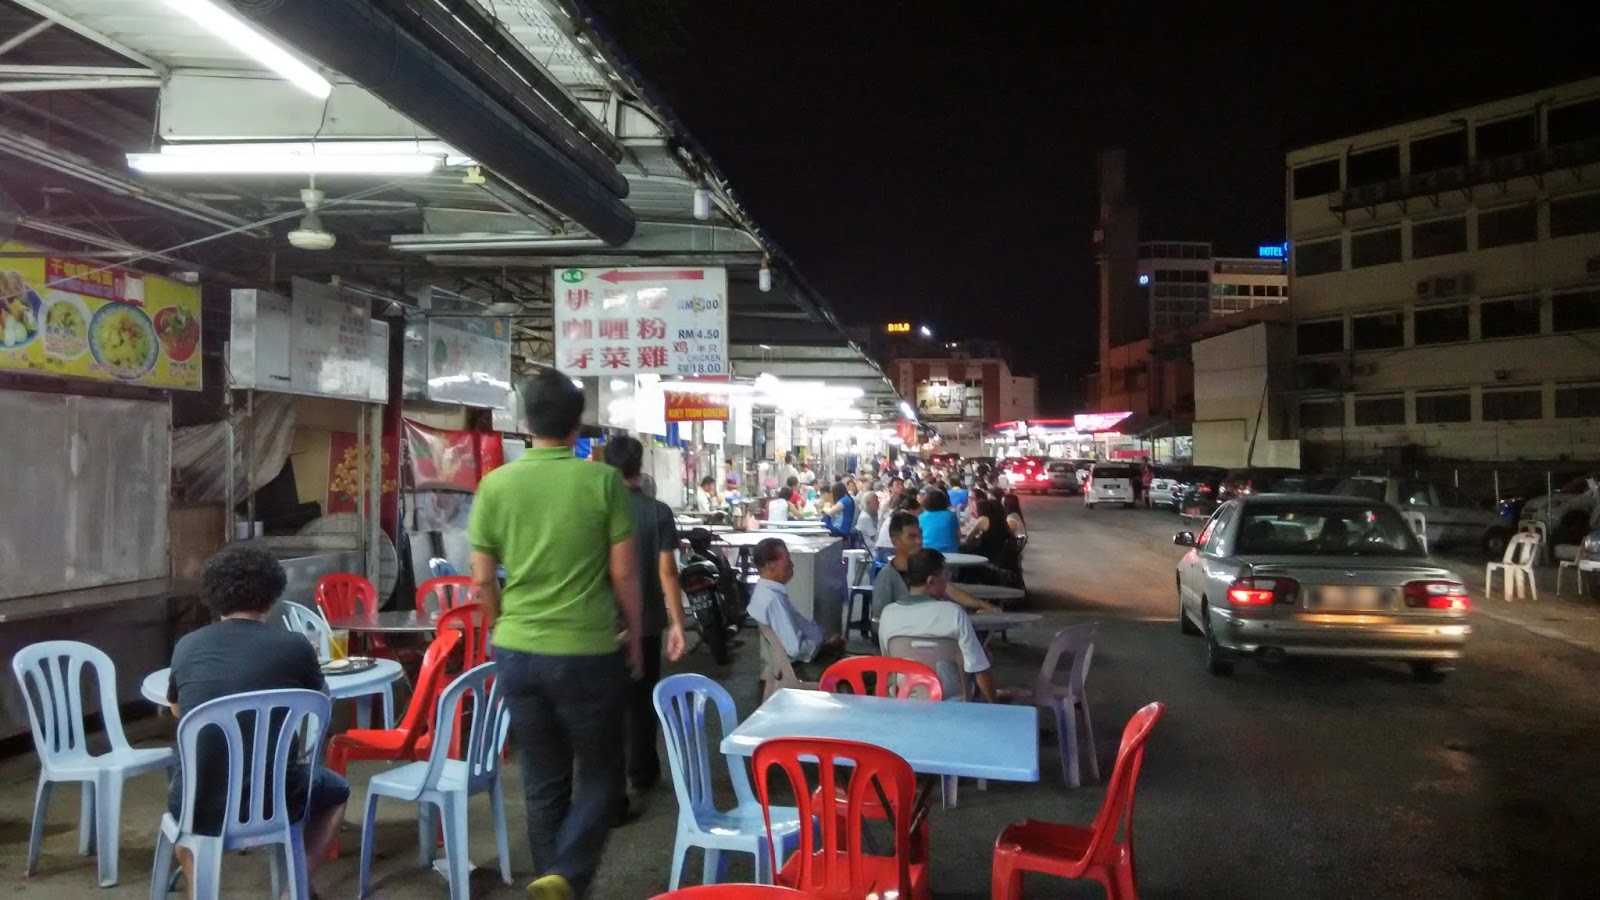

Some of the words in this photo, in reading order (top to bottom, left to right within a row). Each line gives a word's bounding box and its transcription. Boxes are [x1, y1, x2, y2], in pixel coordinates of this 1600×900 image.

[1259, 246, 1283, 257] HOTEL
[678, 329, 694, 339] RM
[697, 329, 720, 339] 4.50
[687, 354, 721, 362] CHICKEN
[678, 364, 690, 373] RM
[692, 363, 721, 373] 18.00
